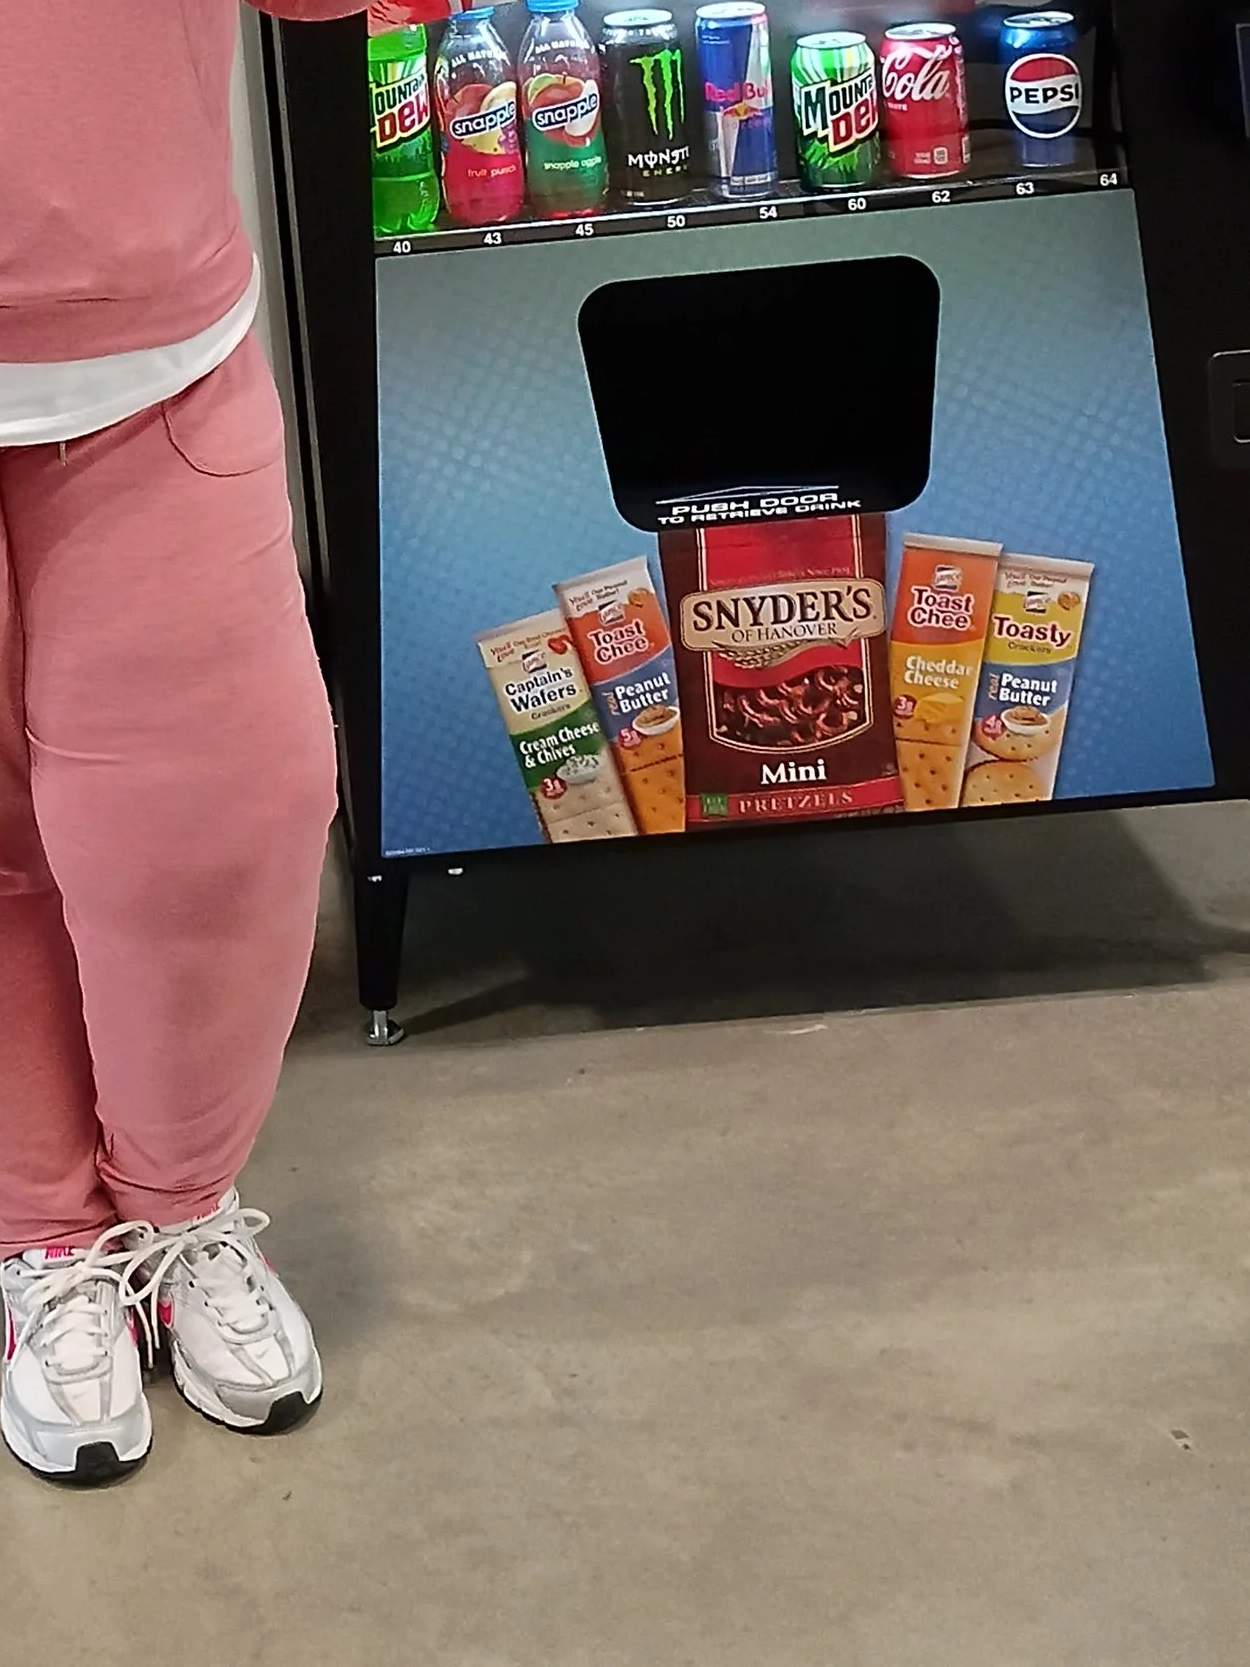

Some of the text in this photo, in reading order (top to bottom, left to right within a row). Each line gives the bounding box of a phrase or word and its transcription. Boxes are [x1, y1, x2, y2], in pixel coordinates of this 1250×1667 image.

[880, 44, 950, 102] Cola
[705, 80, 739, 103] Red
[1010, 82, 1079, 104] PEPSI
[452, 102, 516, 135] snapple
[535, 92, 598, 127] snapple
[467, 165, 517, 178] fruit punch
[1100, 173, 1118, 186] 64
[932, 190, 950, 204] 62
[1016, 182, 1035, 196] 63
[758, 205, 778, 219] 54
[848, 197, 867, 211] 60
[575, 222, 594, 236] 45
[666, 214, 686, 228] 50
[393, 240, 411, 254] 40
[483, 231, 502, 245] 43
[657, 499, 862, 525] TO RETRIEVE DRINK
[671, 493, 839, 516] PUSH DOOR
[692, 586, 872, 633] SNYDER'S
[912, 589, 973, 613] Toast
[910, 608, 970, 630] Chee
[590, 620, 644, 646] Toast
[731, 622, 838, 644] OF HANOVER
[993, 615, 1071, 647] Toasty
[596, 638, 649, 665] Chee
[906, 655, 972, 676] Cheddar
[504, 668, 574, 695] Captain's
[615, 672, 671, 700] Peanut
[904, 670, 960, 690] Cheese
[1001, 672, 1058, 694] Peanut
[511, 684, 576, 713] Wafers
[620, 688, 670, 714] Butter
[999, 687, 1051, 707] Butter
[519, 721, 600, 755] Cream Cheese
[525, 743, 577, 768] & Chives
[760, 759, 828, 785] Mini
[739, 791, 854, 814] PRETZELS
